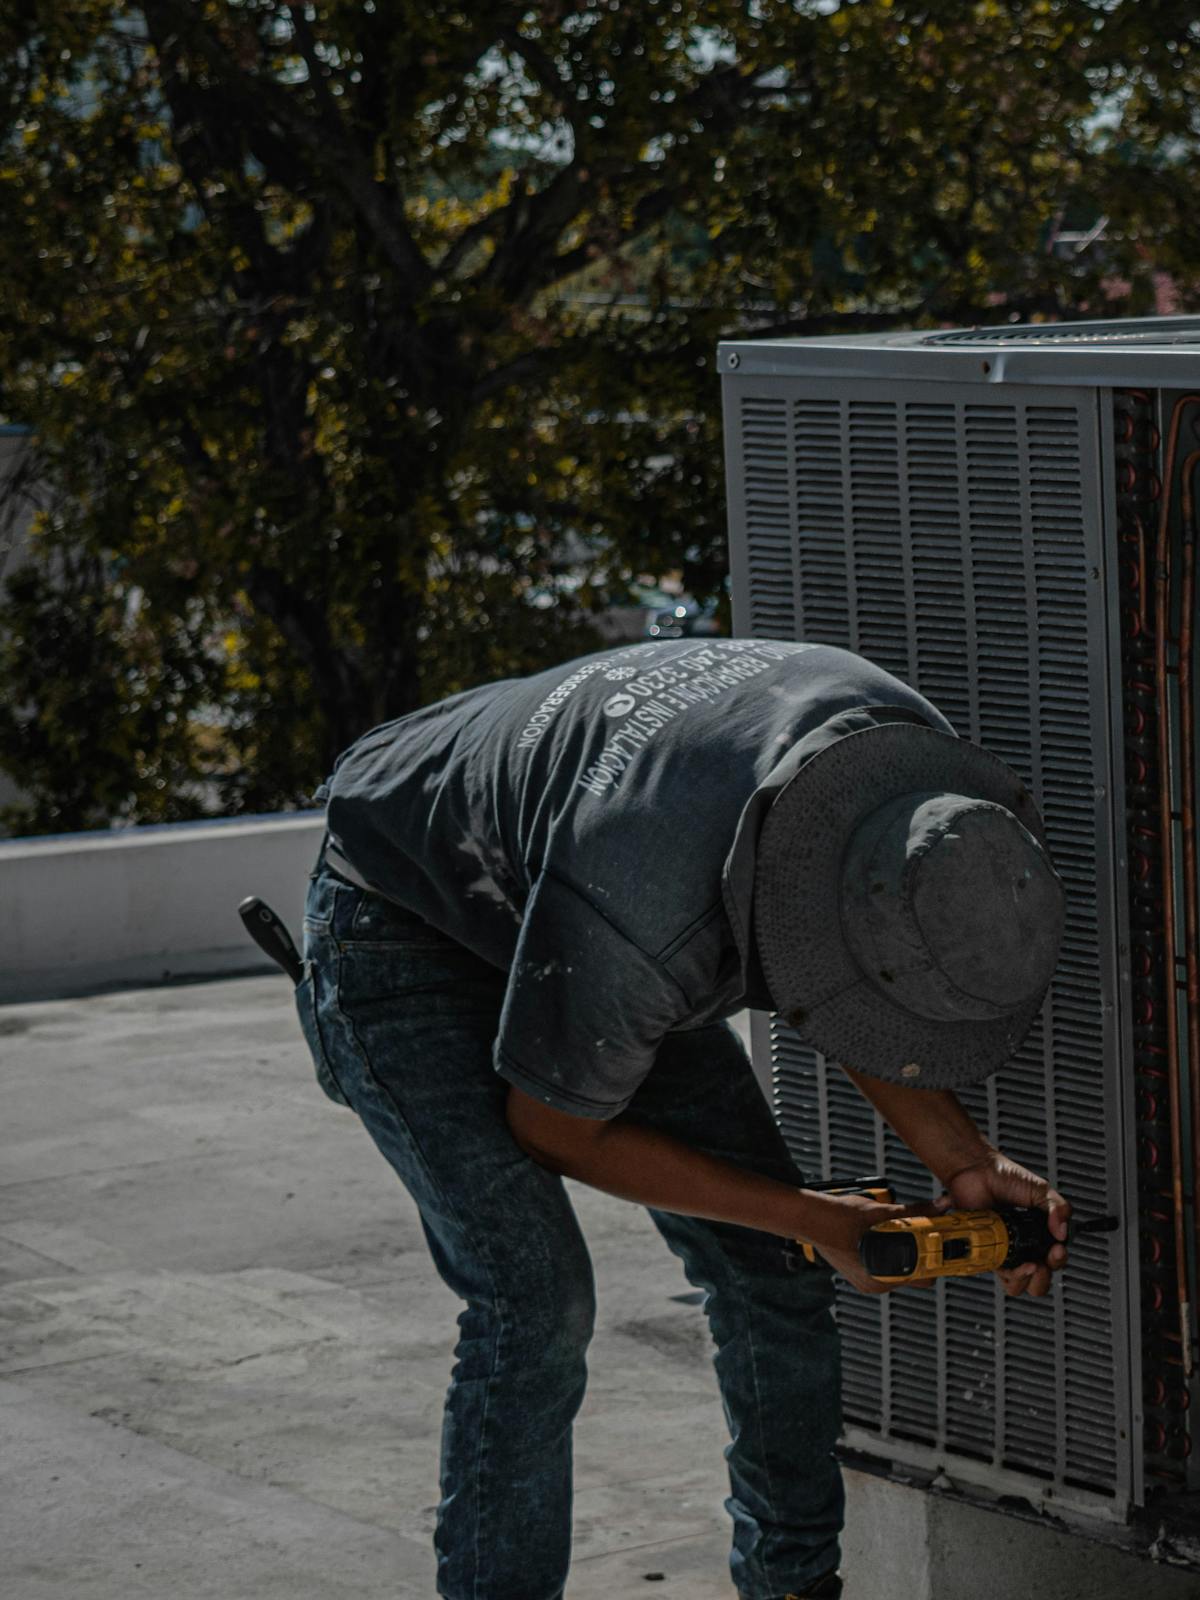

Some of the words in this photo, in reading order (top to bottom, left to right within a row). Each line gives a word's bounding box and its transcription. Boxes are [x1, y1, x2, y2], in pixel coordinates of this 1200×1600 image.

[678, 649, 727, 671] 240
[625, 666, 688, 696] 3230
[668, 652, 770, 704] REPARACIÓN
[658, 692, 688, 710] E
[577, 699, 677, 796] INSTALACIÓN
